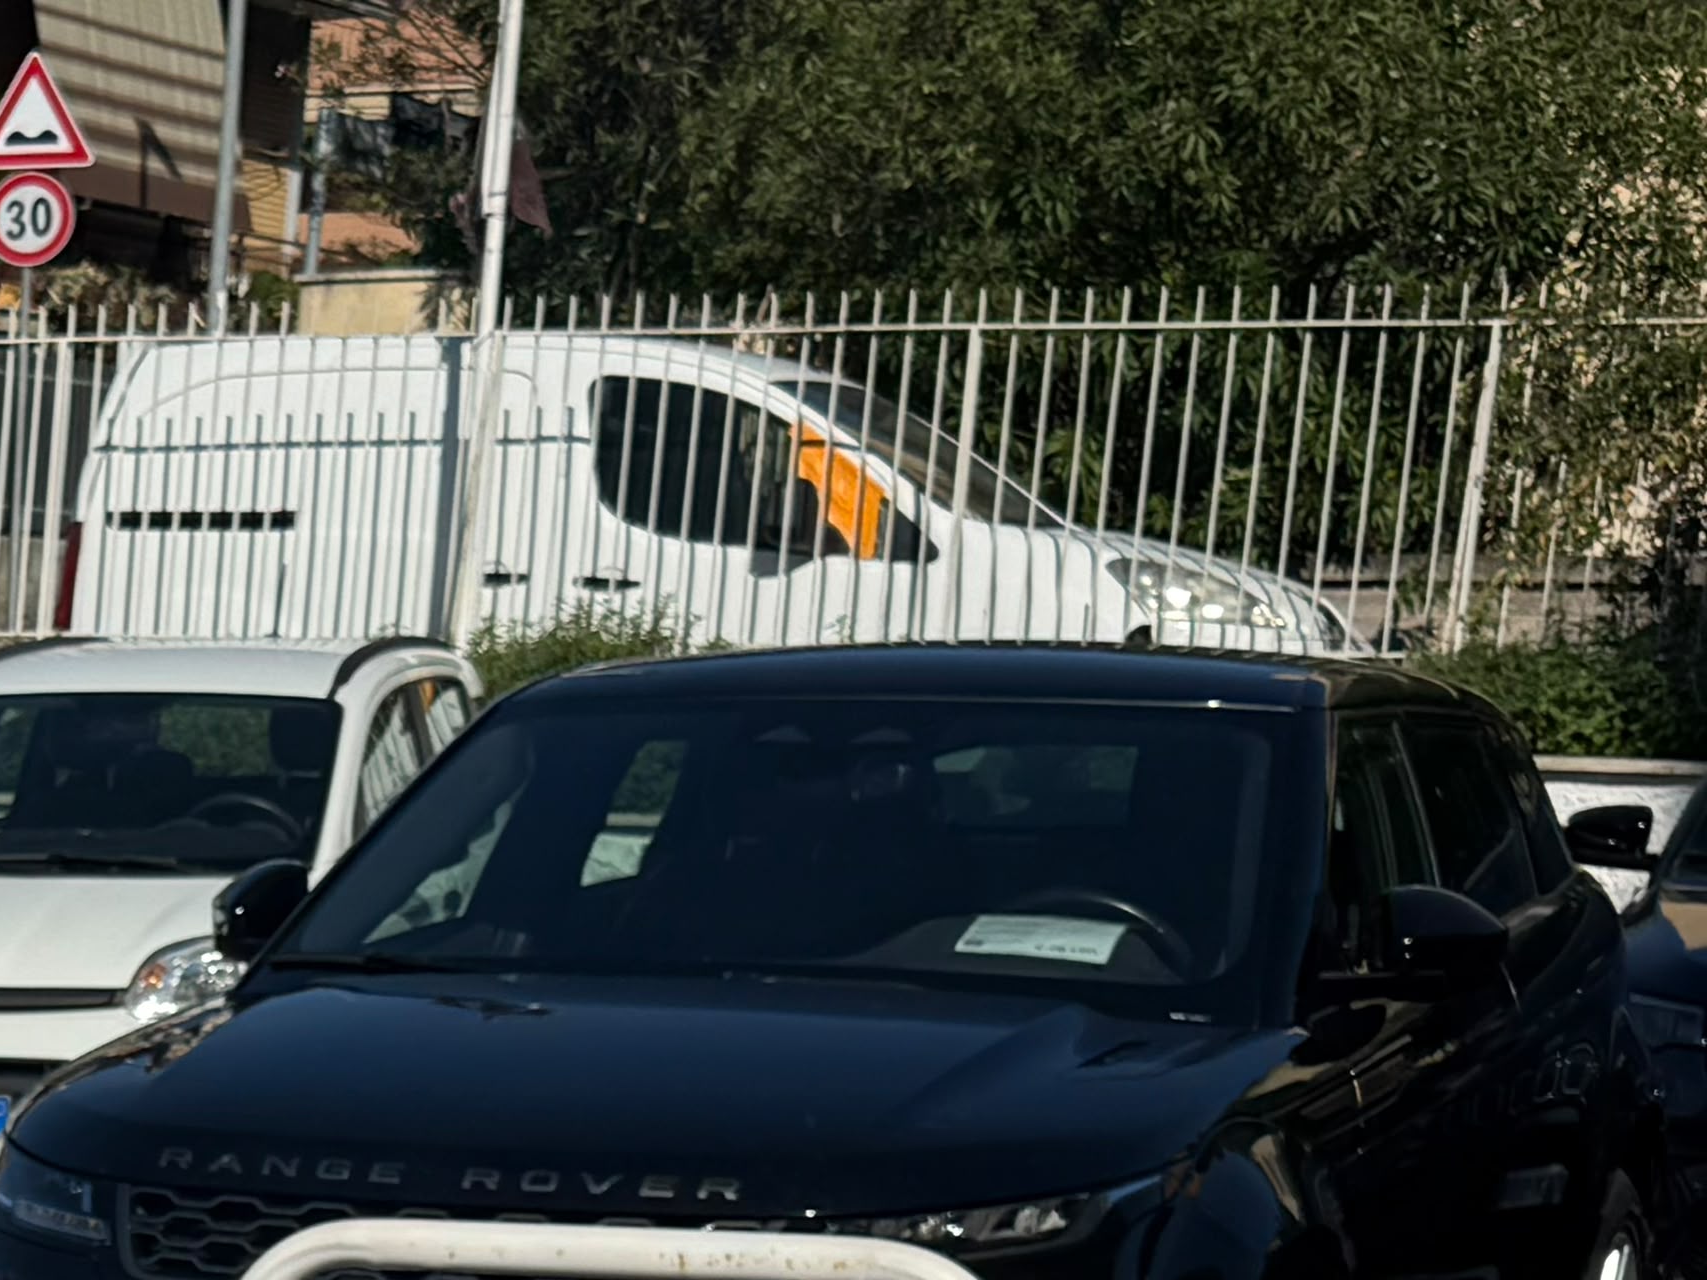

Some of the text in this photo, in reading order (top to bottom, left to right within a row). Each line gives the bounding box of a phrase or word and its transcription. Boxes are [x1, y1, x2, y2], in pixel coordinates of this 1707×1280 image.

[6, 197, 51, 241] 30
[158, 1146, 742, 1200] RANGE ROVER
